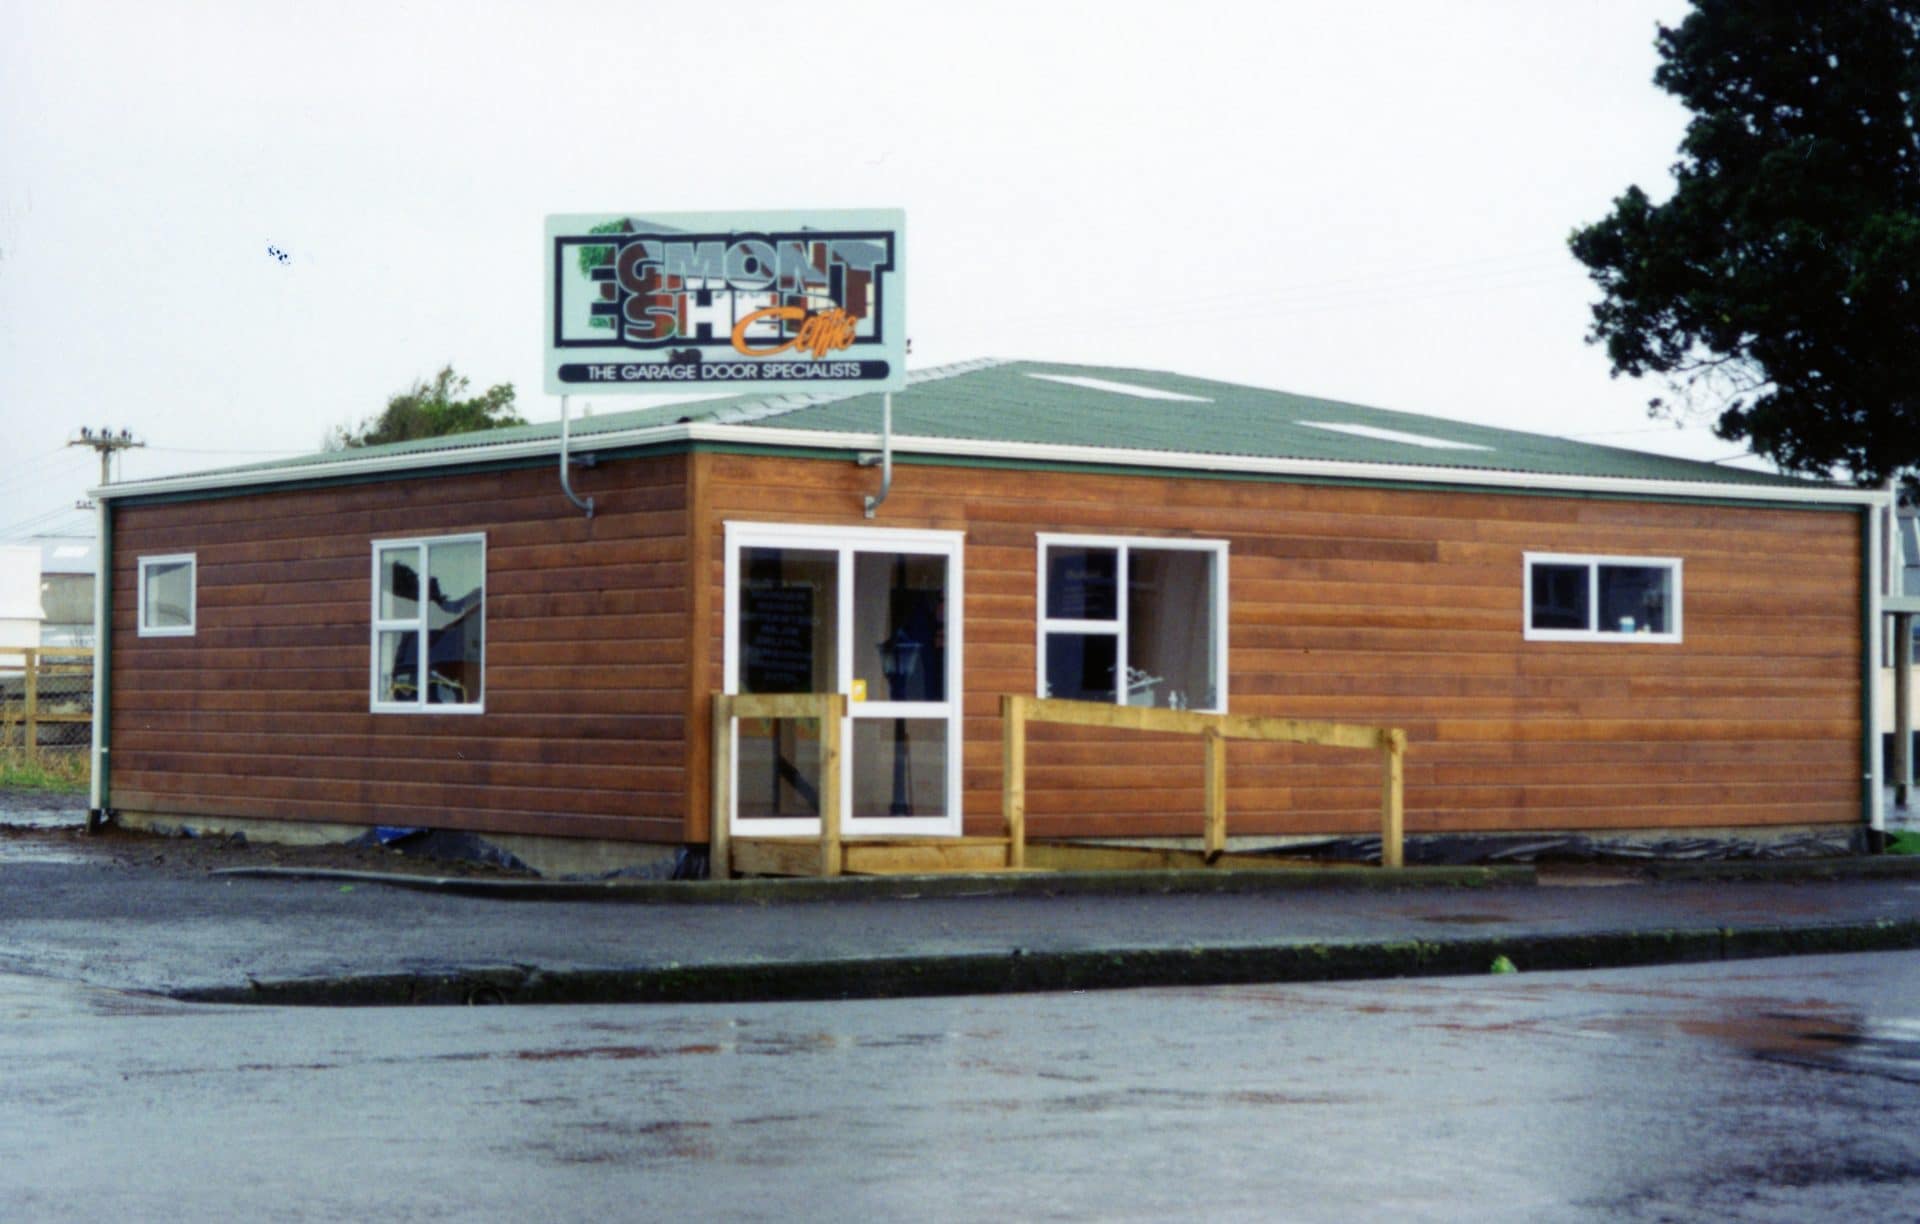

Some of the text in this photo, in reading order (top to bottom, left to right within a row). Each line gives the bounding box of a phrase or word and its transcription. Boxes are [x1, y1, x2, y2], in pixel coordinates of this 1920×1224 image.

[562, 237, 887, 340] EGMONT
[588, 362, 862, 381] THE GARAGE DOOR SPECIALISTS
